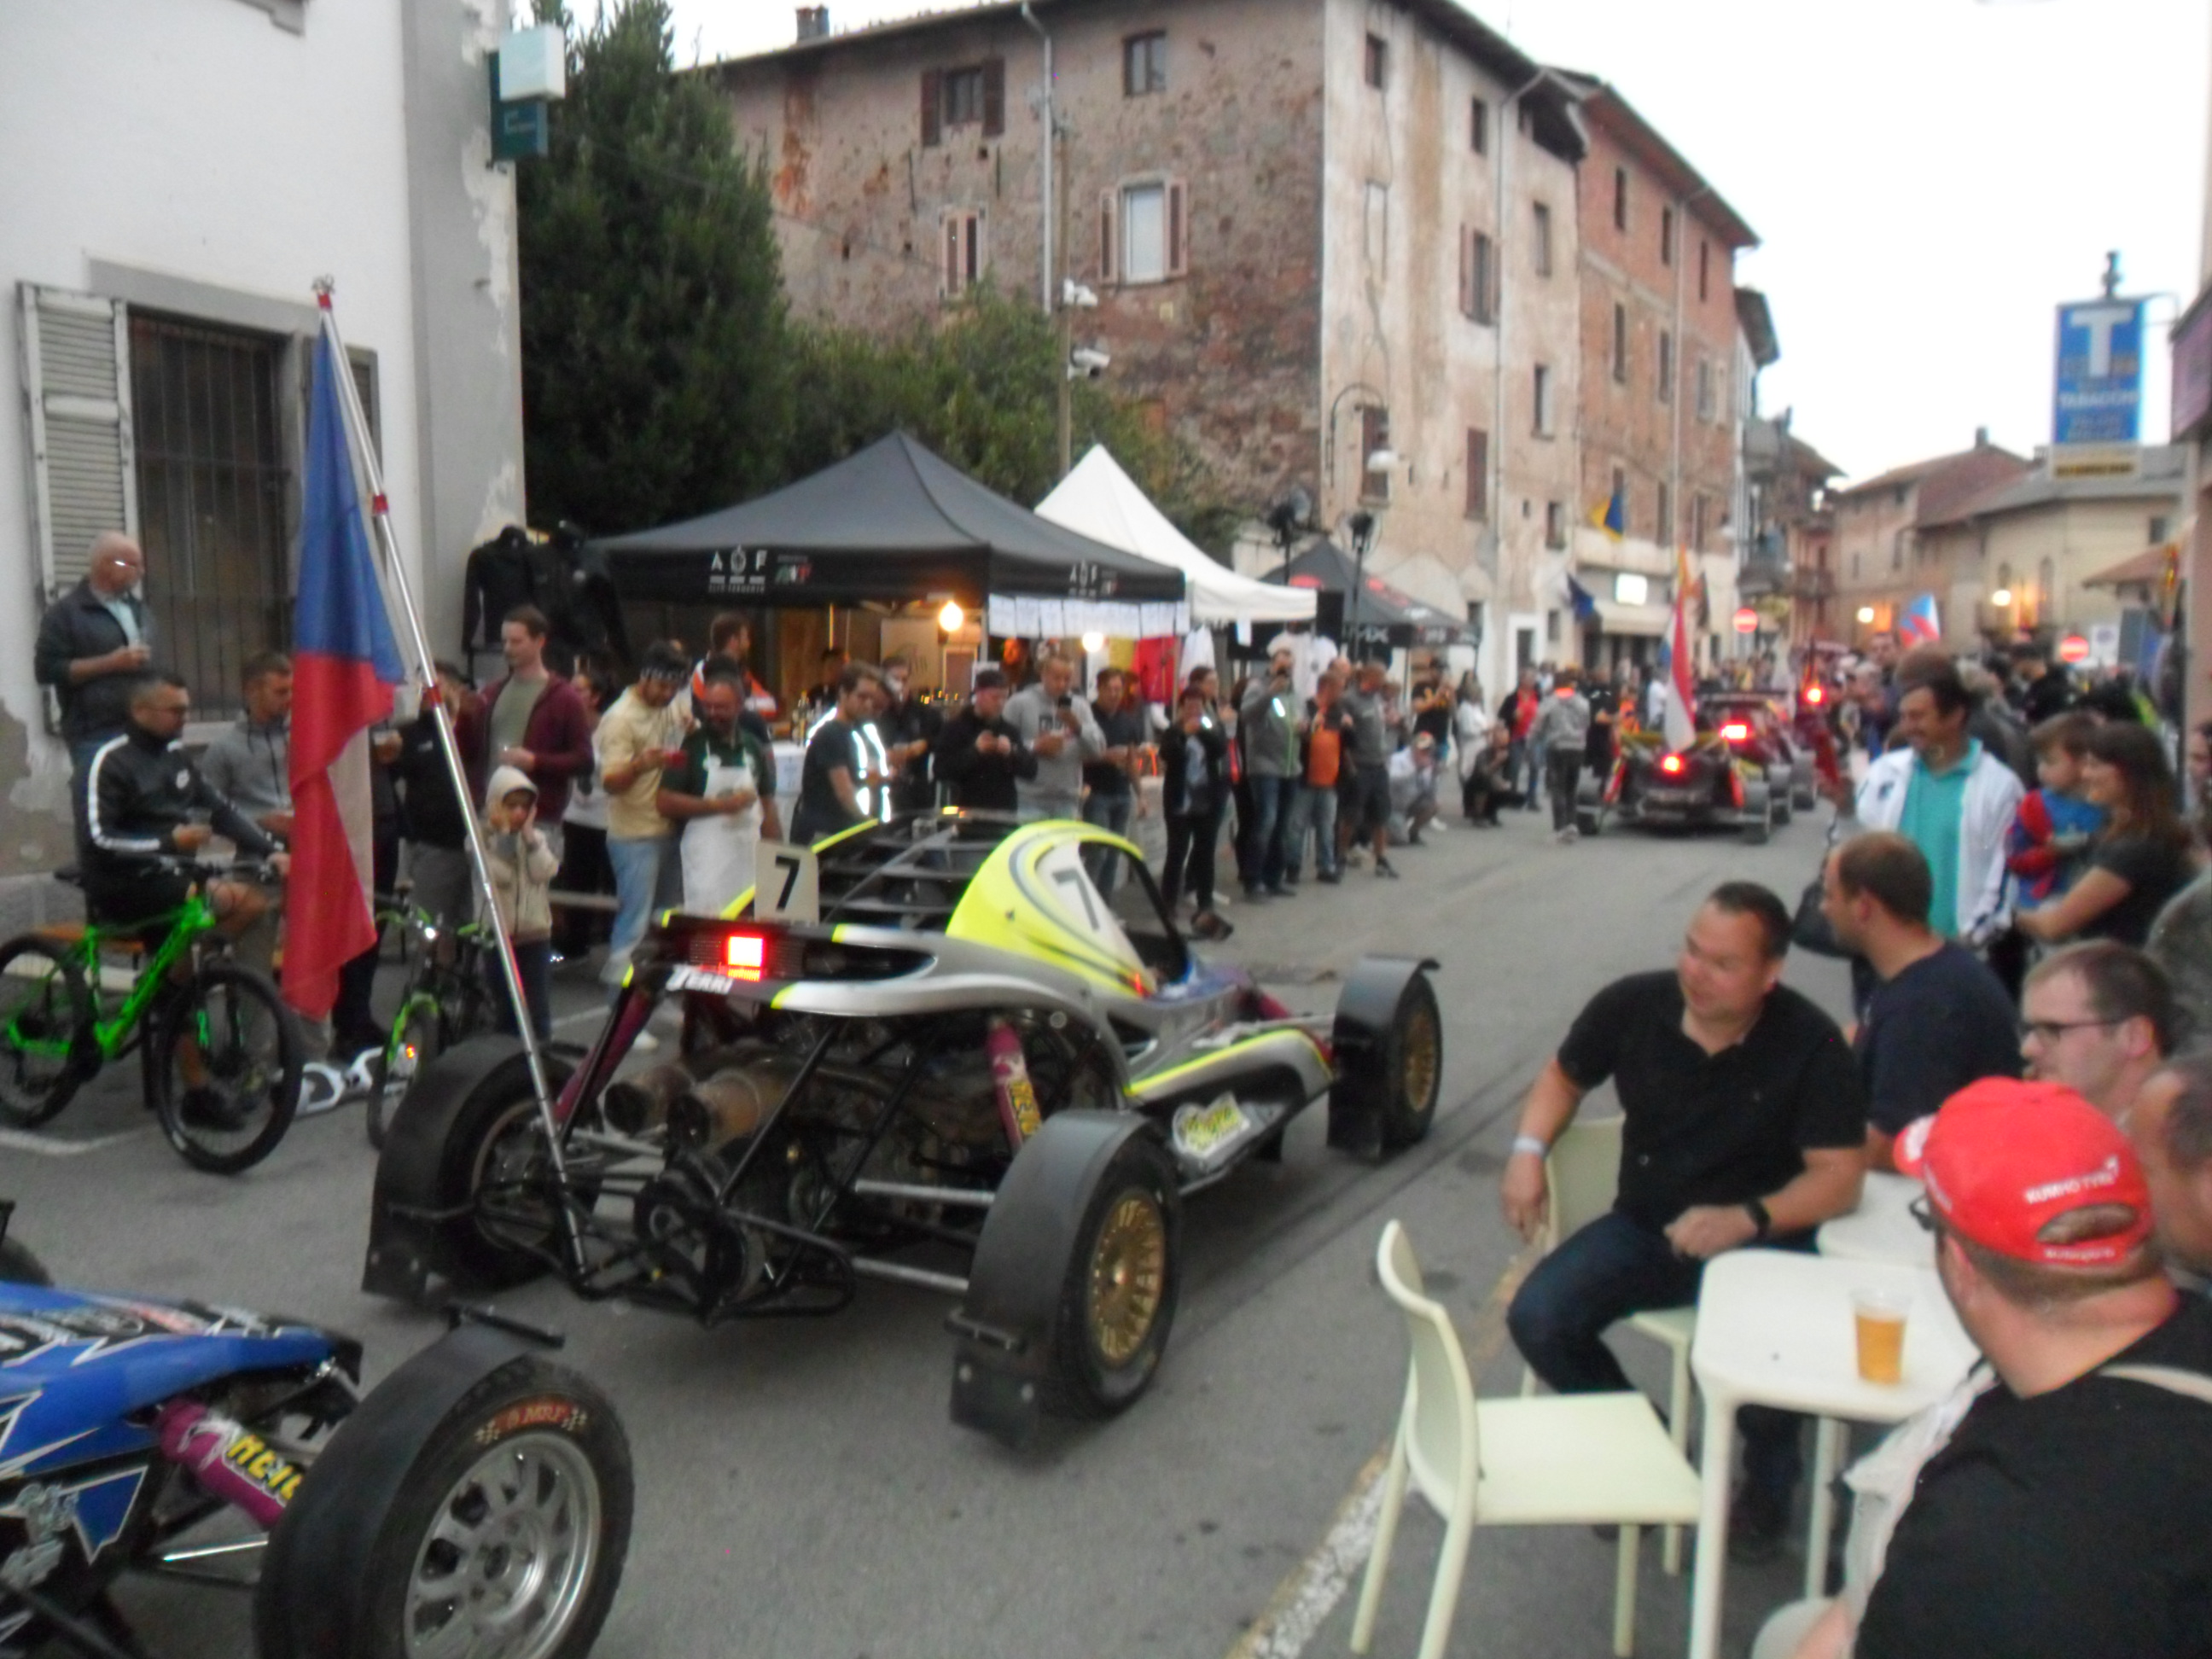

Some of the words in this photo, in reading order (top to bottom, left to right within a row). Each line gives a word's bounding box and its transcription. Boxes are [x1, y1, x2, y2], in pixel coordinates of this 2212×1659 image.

[2070, 308, 2133, 378] T
[775, 854, 800, 911] 7
[1051, 866, 1100, 930] 7
